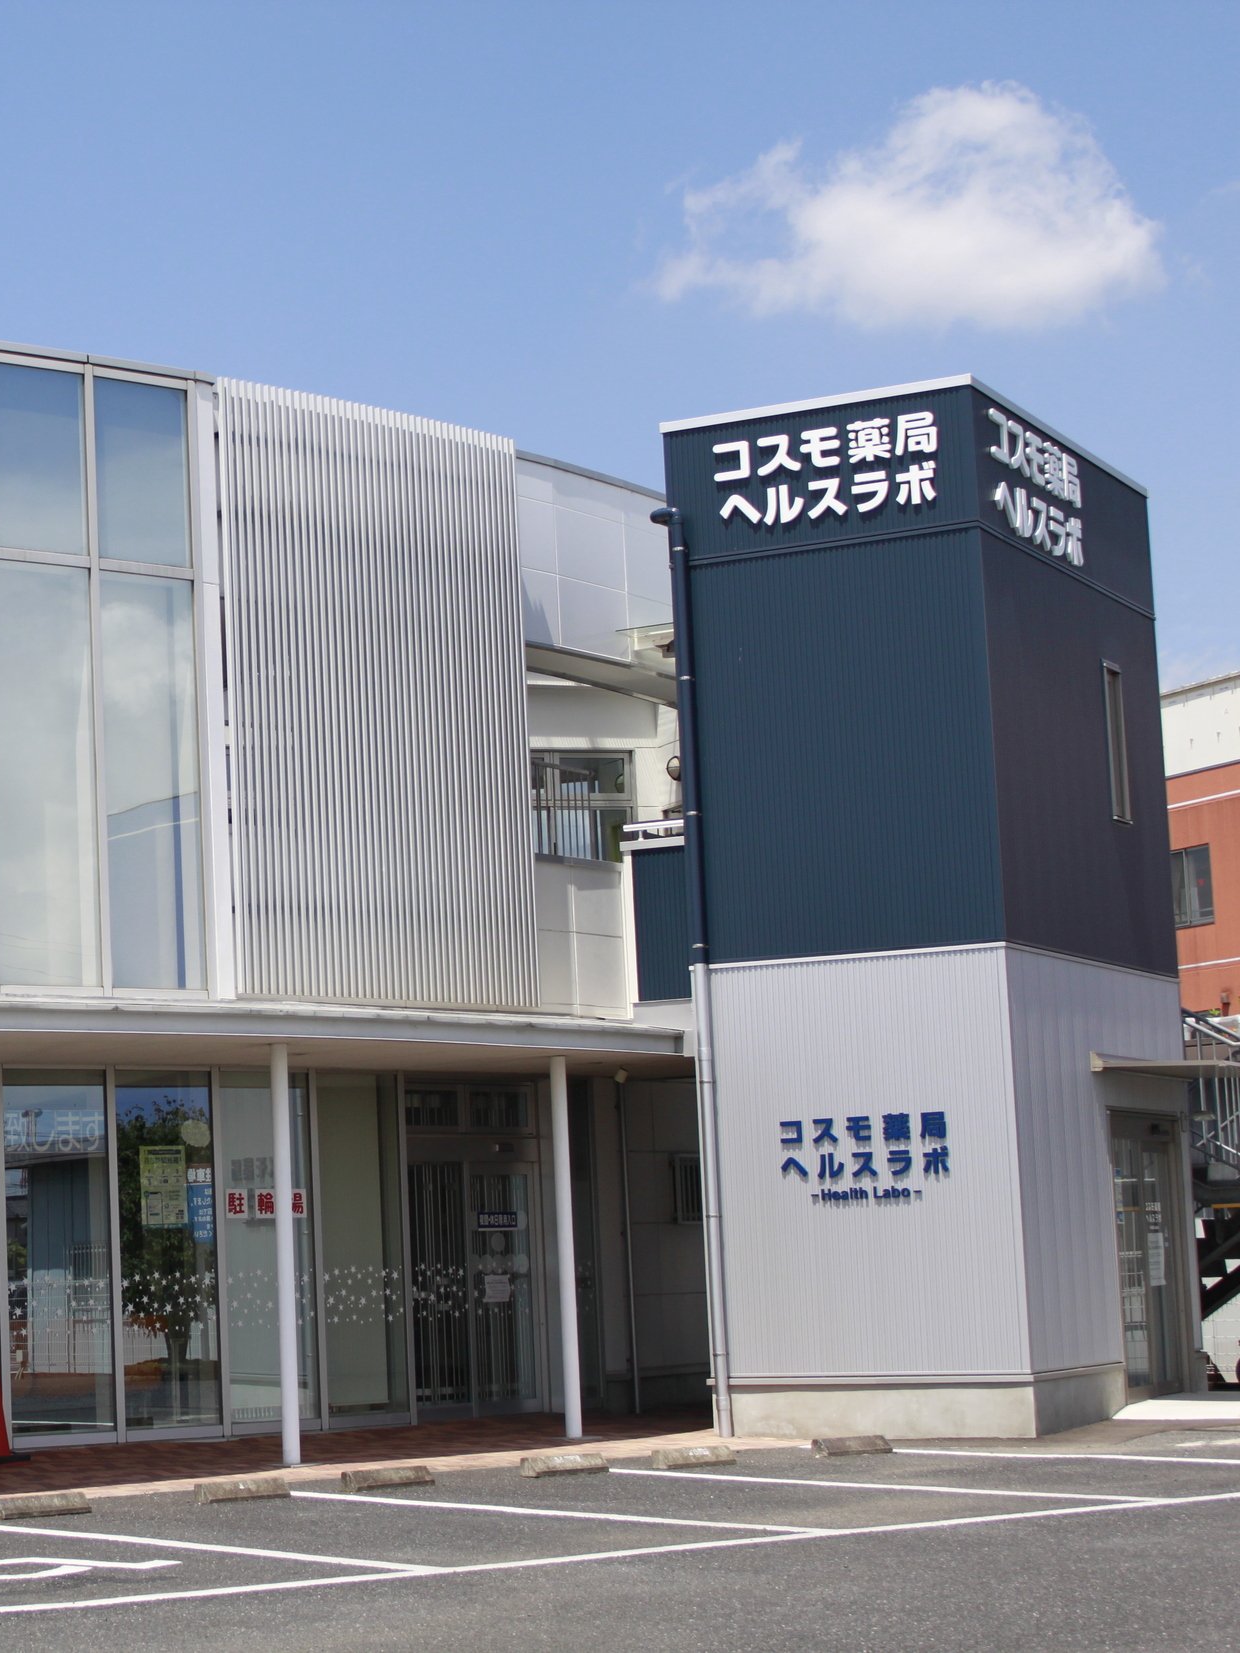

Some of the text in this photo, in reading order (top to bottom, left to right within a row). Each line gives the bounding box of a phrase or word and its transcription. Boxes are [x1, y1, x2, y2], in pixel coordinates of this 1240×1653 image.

[712, 411, 938, 482] コスモ薬局
[988, 407, 1082, 508] コスモ薬局
[719, 465, 937, 526] ヘルスラボ
[994, 481, 1084, 567] ヘルスラボ
[779, 1111, 947, 1144] コスモ薬局
[781, 1145, 950, 1179] ヘルスラボ
